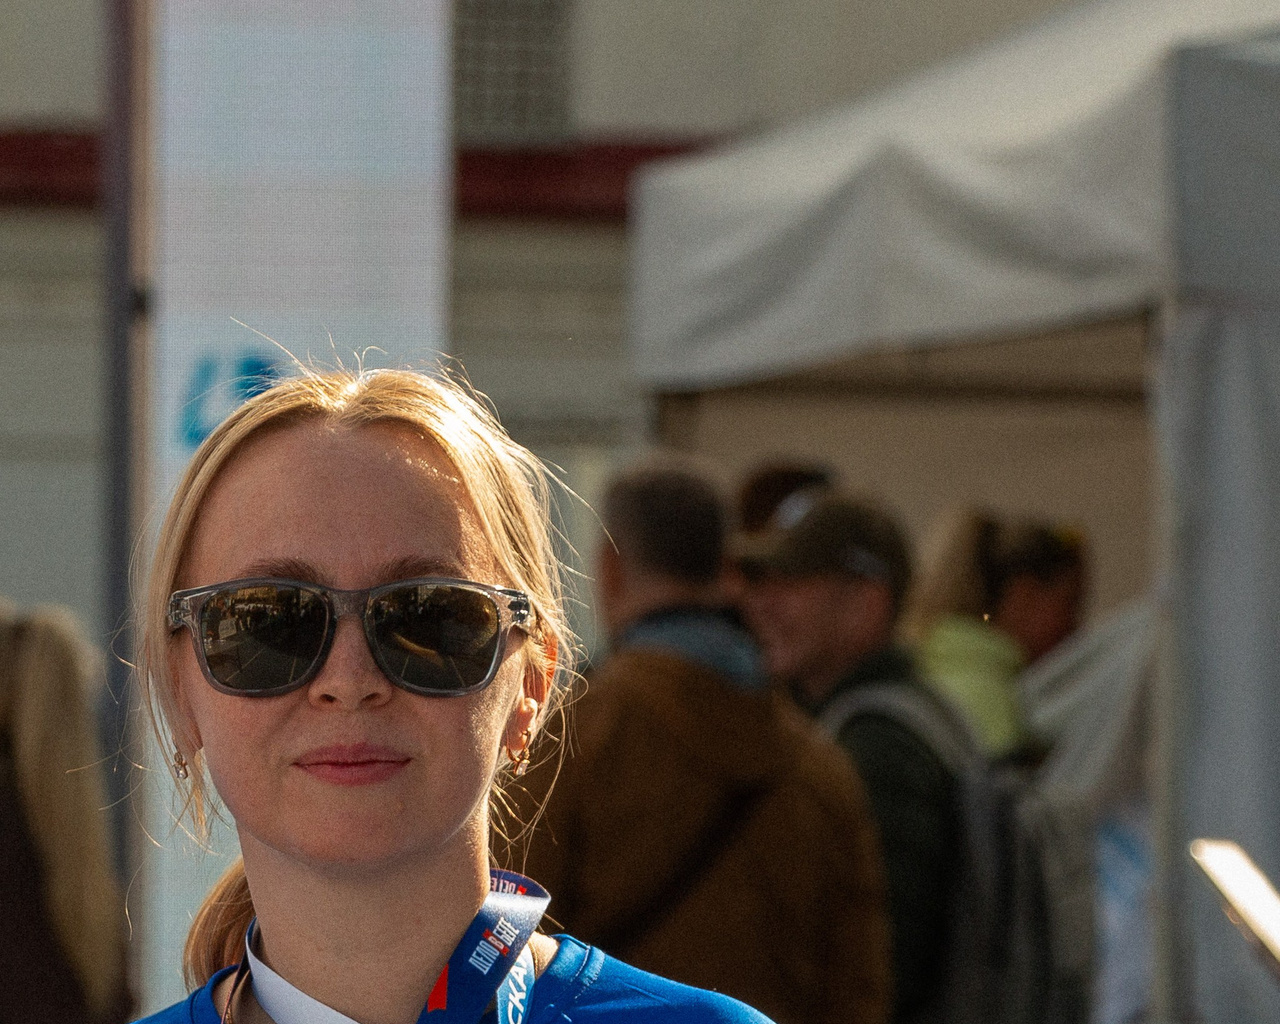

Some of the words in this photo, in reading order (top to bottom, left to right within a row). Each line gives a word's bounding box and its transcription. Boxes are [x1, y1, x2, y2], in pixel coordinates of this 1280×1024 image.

[488, 936, 505, 950] В
[492, 916, 520, 947] БЕГЕ
[469, 940, 500, 975] ДЕЛО
